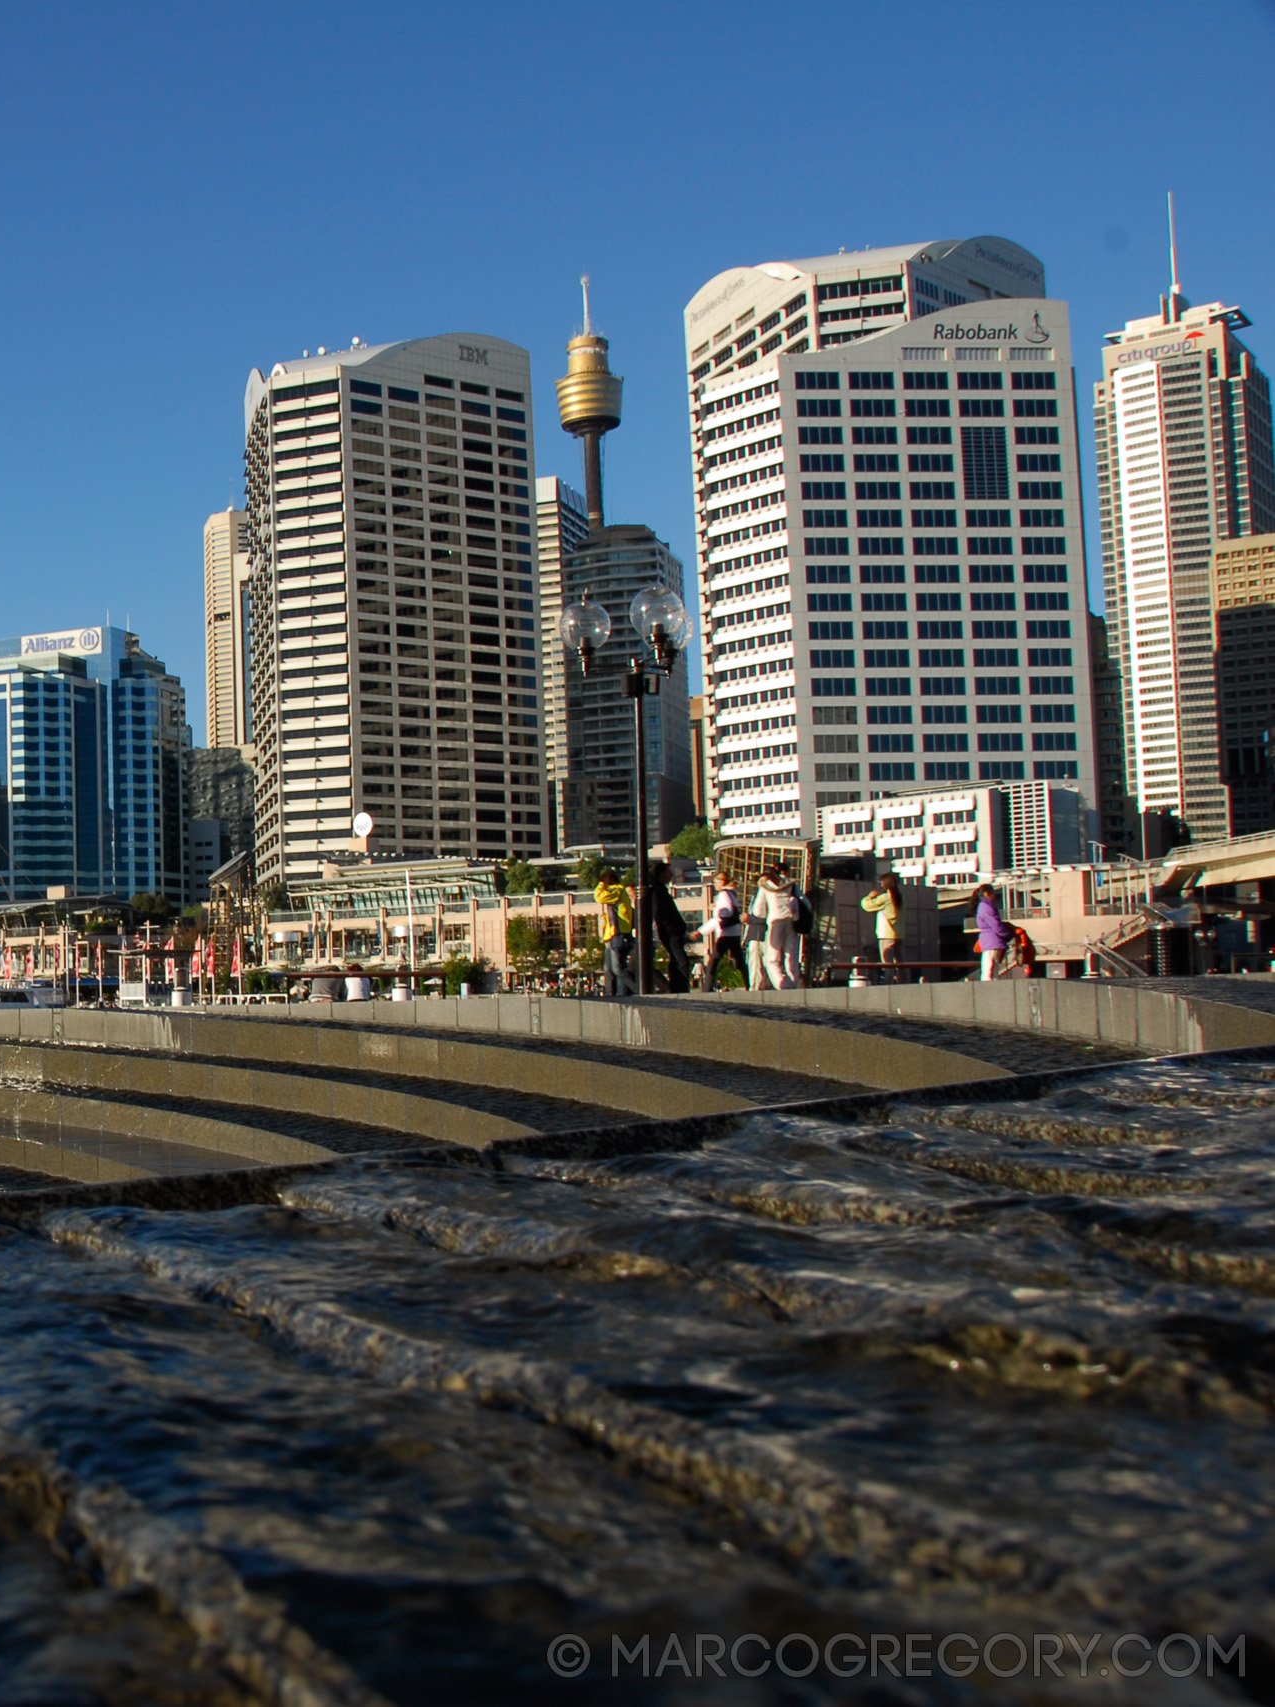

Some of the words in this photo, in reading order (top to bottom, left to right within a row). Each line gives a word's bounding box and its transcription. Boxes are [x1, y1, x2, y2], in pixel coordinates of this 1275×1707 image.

[933, 323, 1018, 340] Rabobank
[458, 344, 489, 366] IBM
[1117, 339, 1192, 363] citigroup
[24, 636, 75, 654] Allianz
